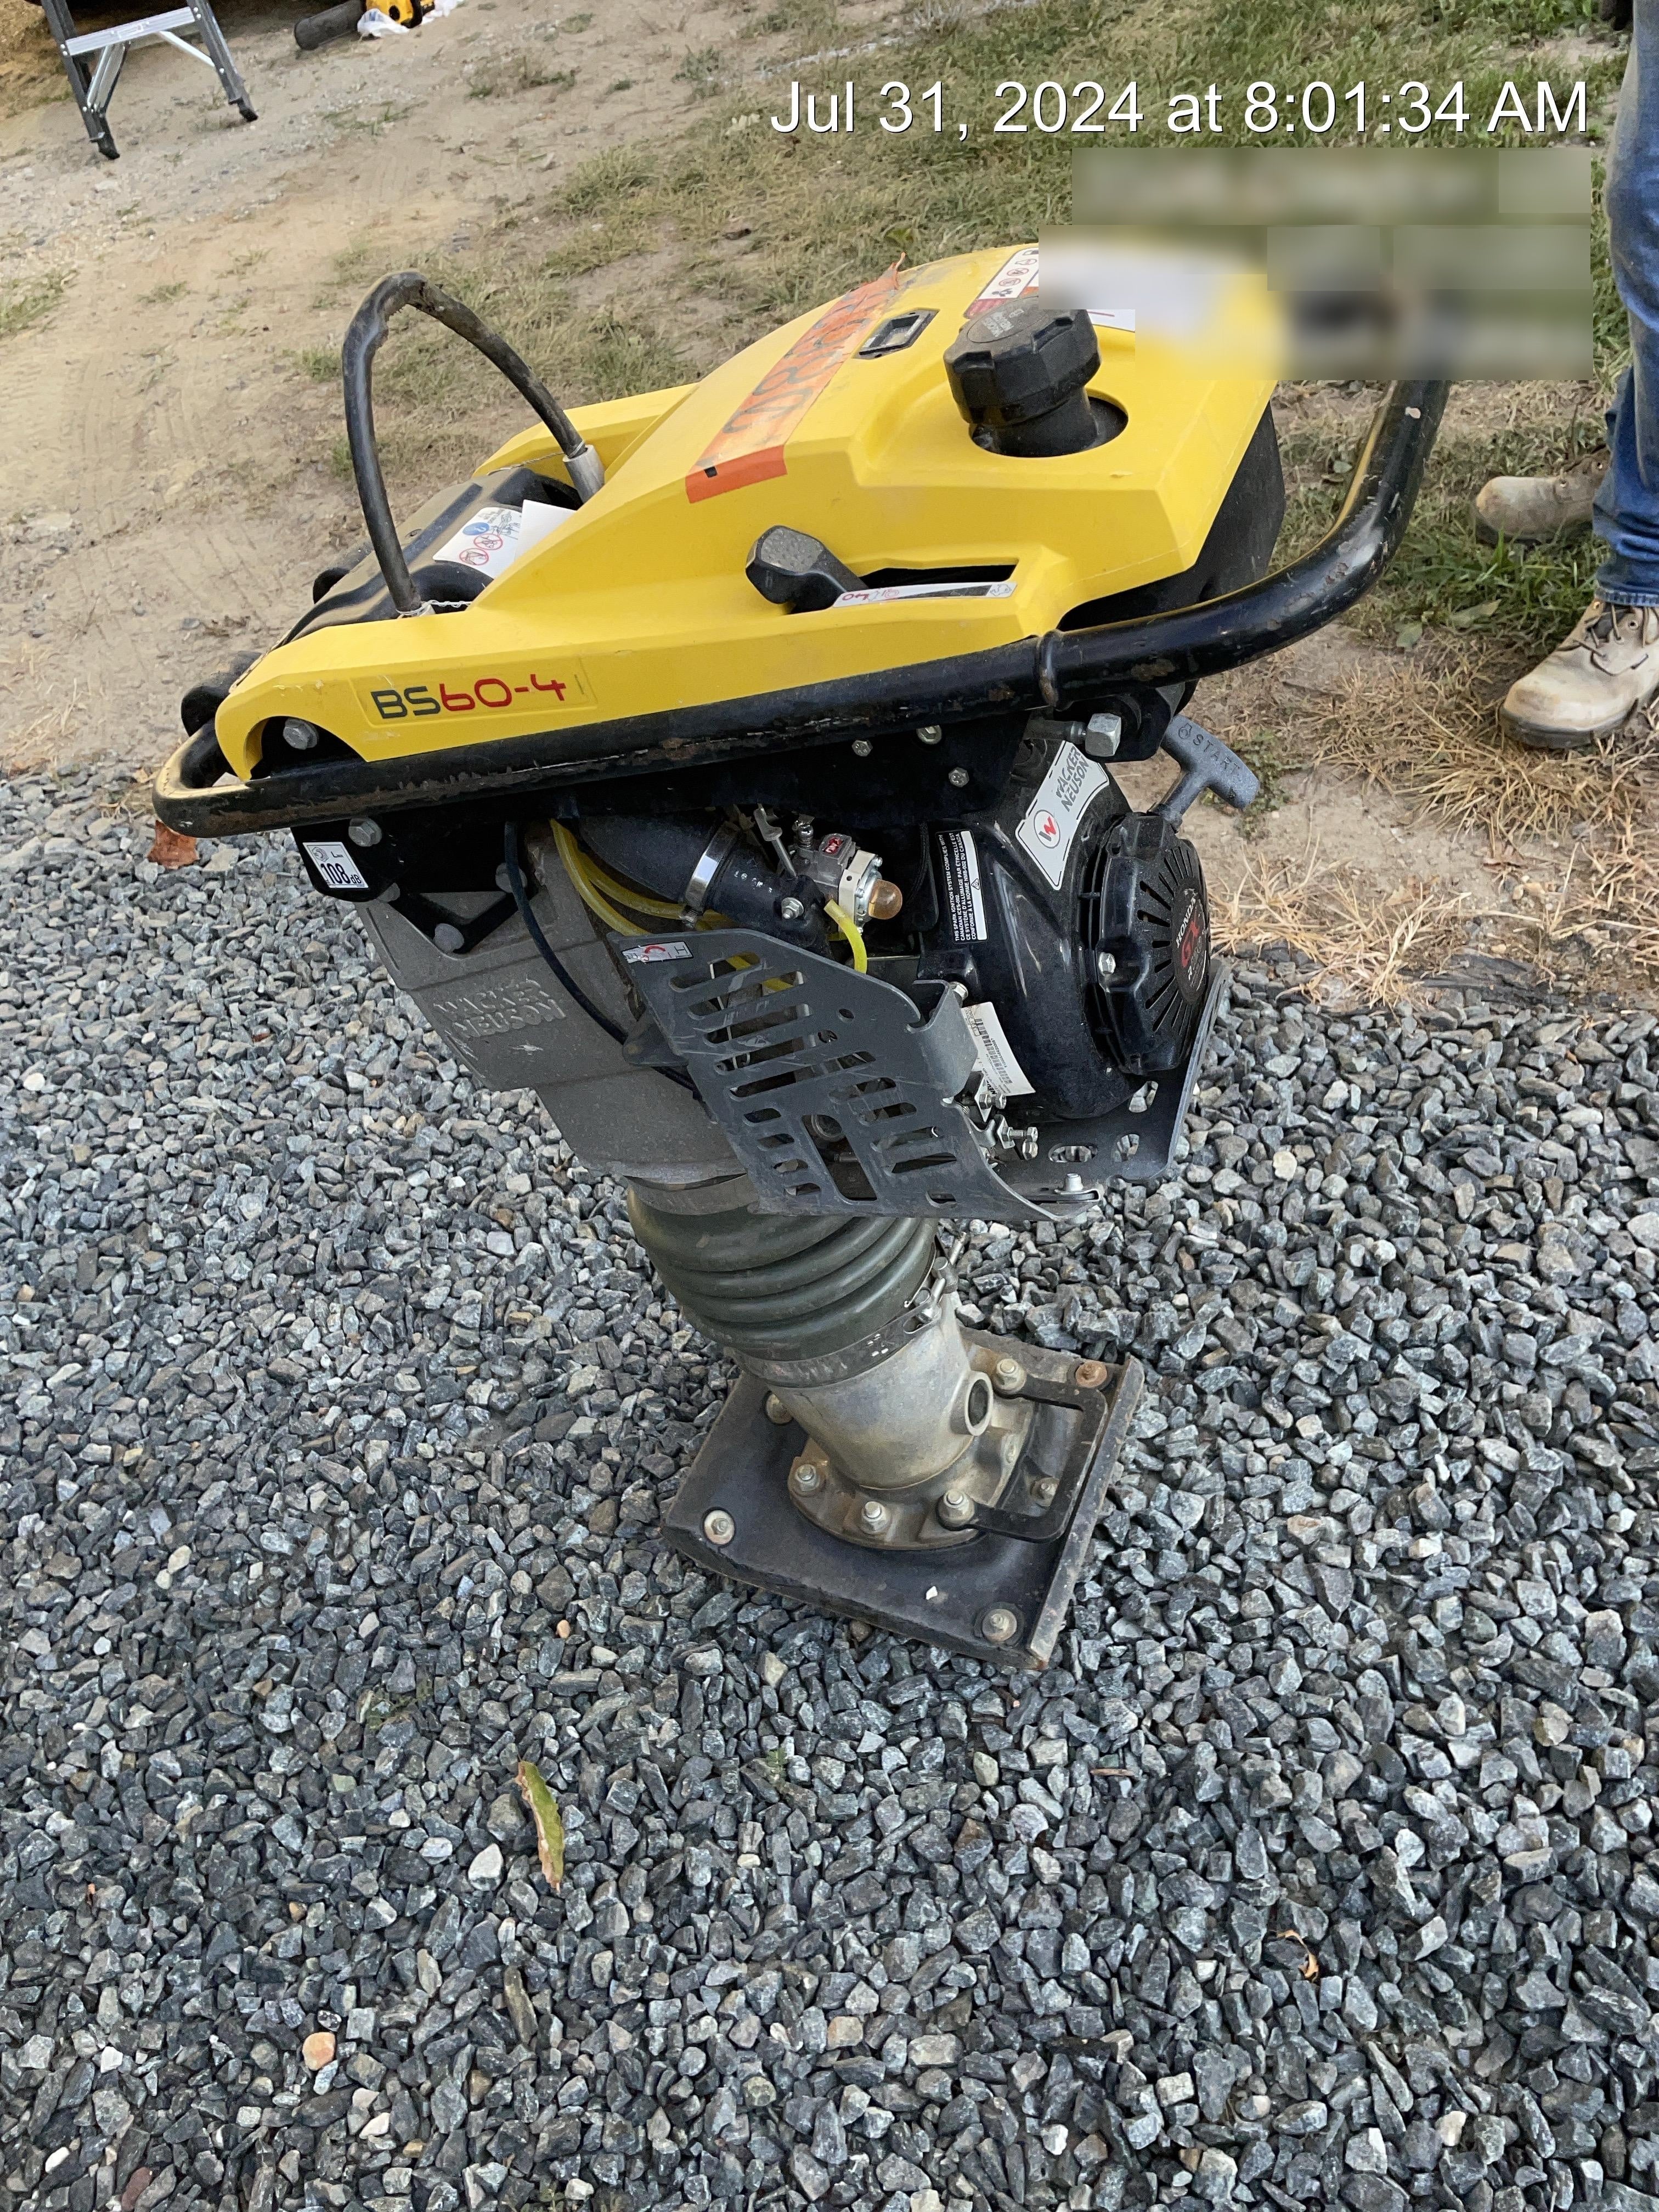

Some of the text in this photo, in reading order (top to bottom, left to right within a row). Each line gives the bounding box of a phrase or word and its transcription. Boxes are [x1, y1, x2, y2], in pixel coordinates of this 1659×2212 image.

[371, 674, 566, 719] BS60-4
[1056, 746, 1080, 798] WACKER
[1193, 734, 1241, 775] START
[1061, 756, 1089, 812] NEUSON
[320, 863, 351, 884] 108
